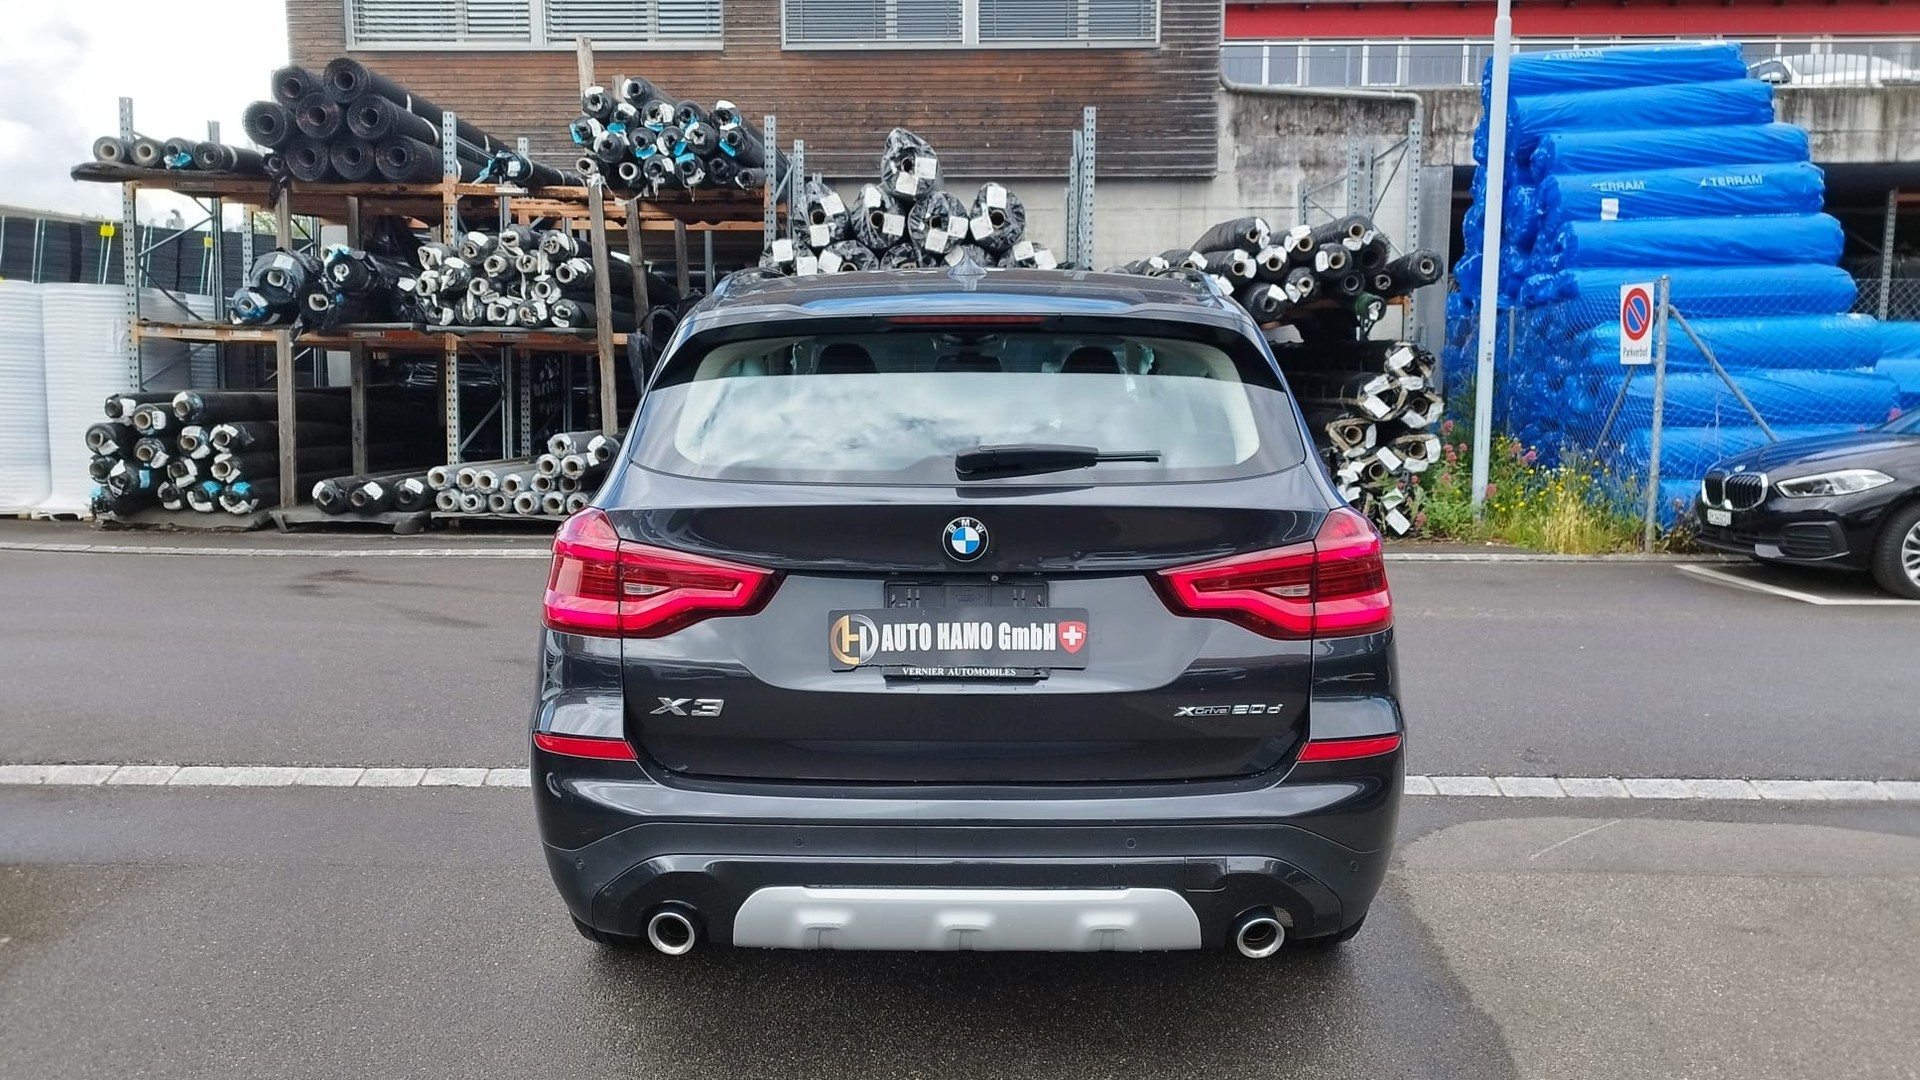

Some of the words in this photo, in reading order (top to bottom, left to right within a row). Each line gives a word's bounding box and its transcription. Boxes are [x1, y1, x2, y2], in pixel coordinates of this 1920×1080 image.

[1710, 174, 1764, 187] TERRAM
[881, 623, 932, 652] AUTO
[937, 622, 994, 651] HAMO
[998, 622, 1057, 651] GmbH
[902, 667, 945, 677] VERNIER
[948, 667, 1017, 677] AUTOMOBILES
[649, 696, 725, 717] X3
